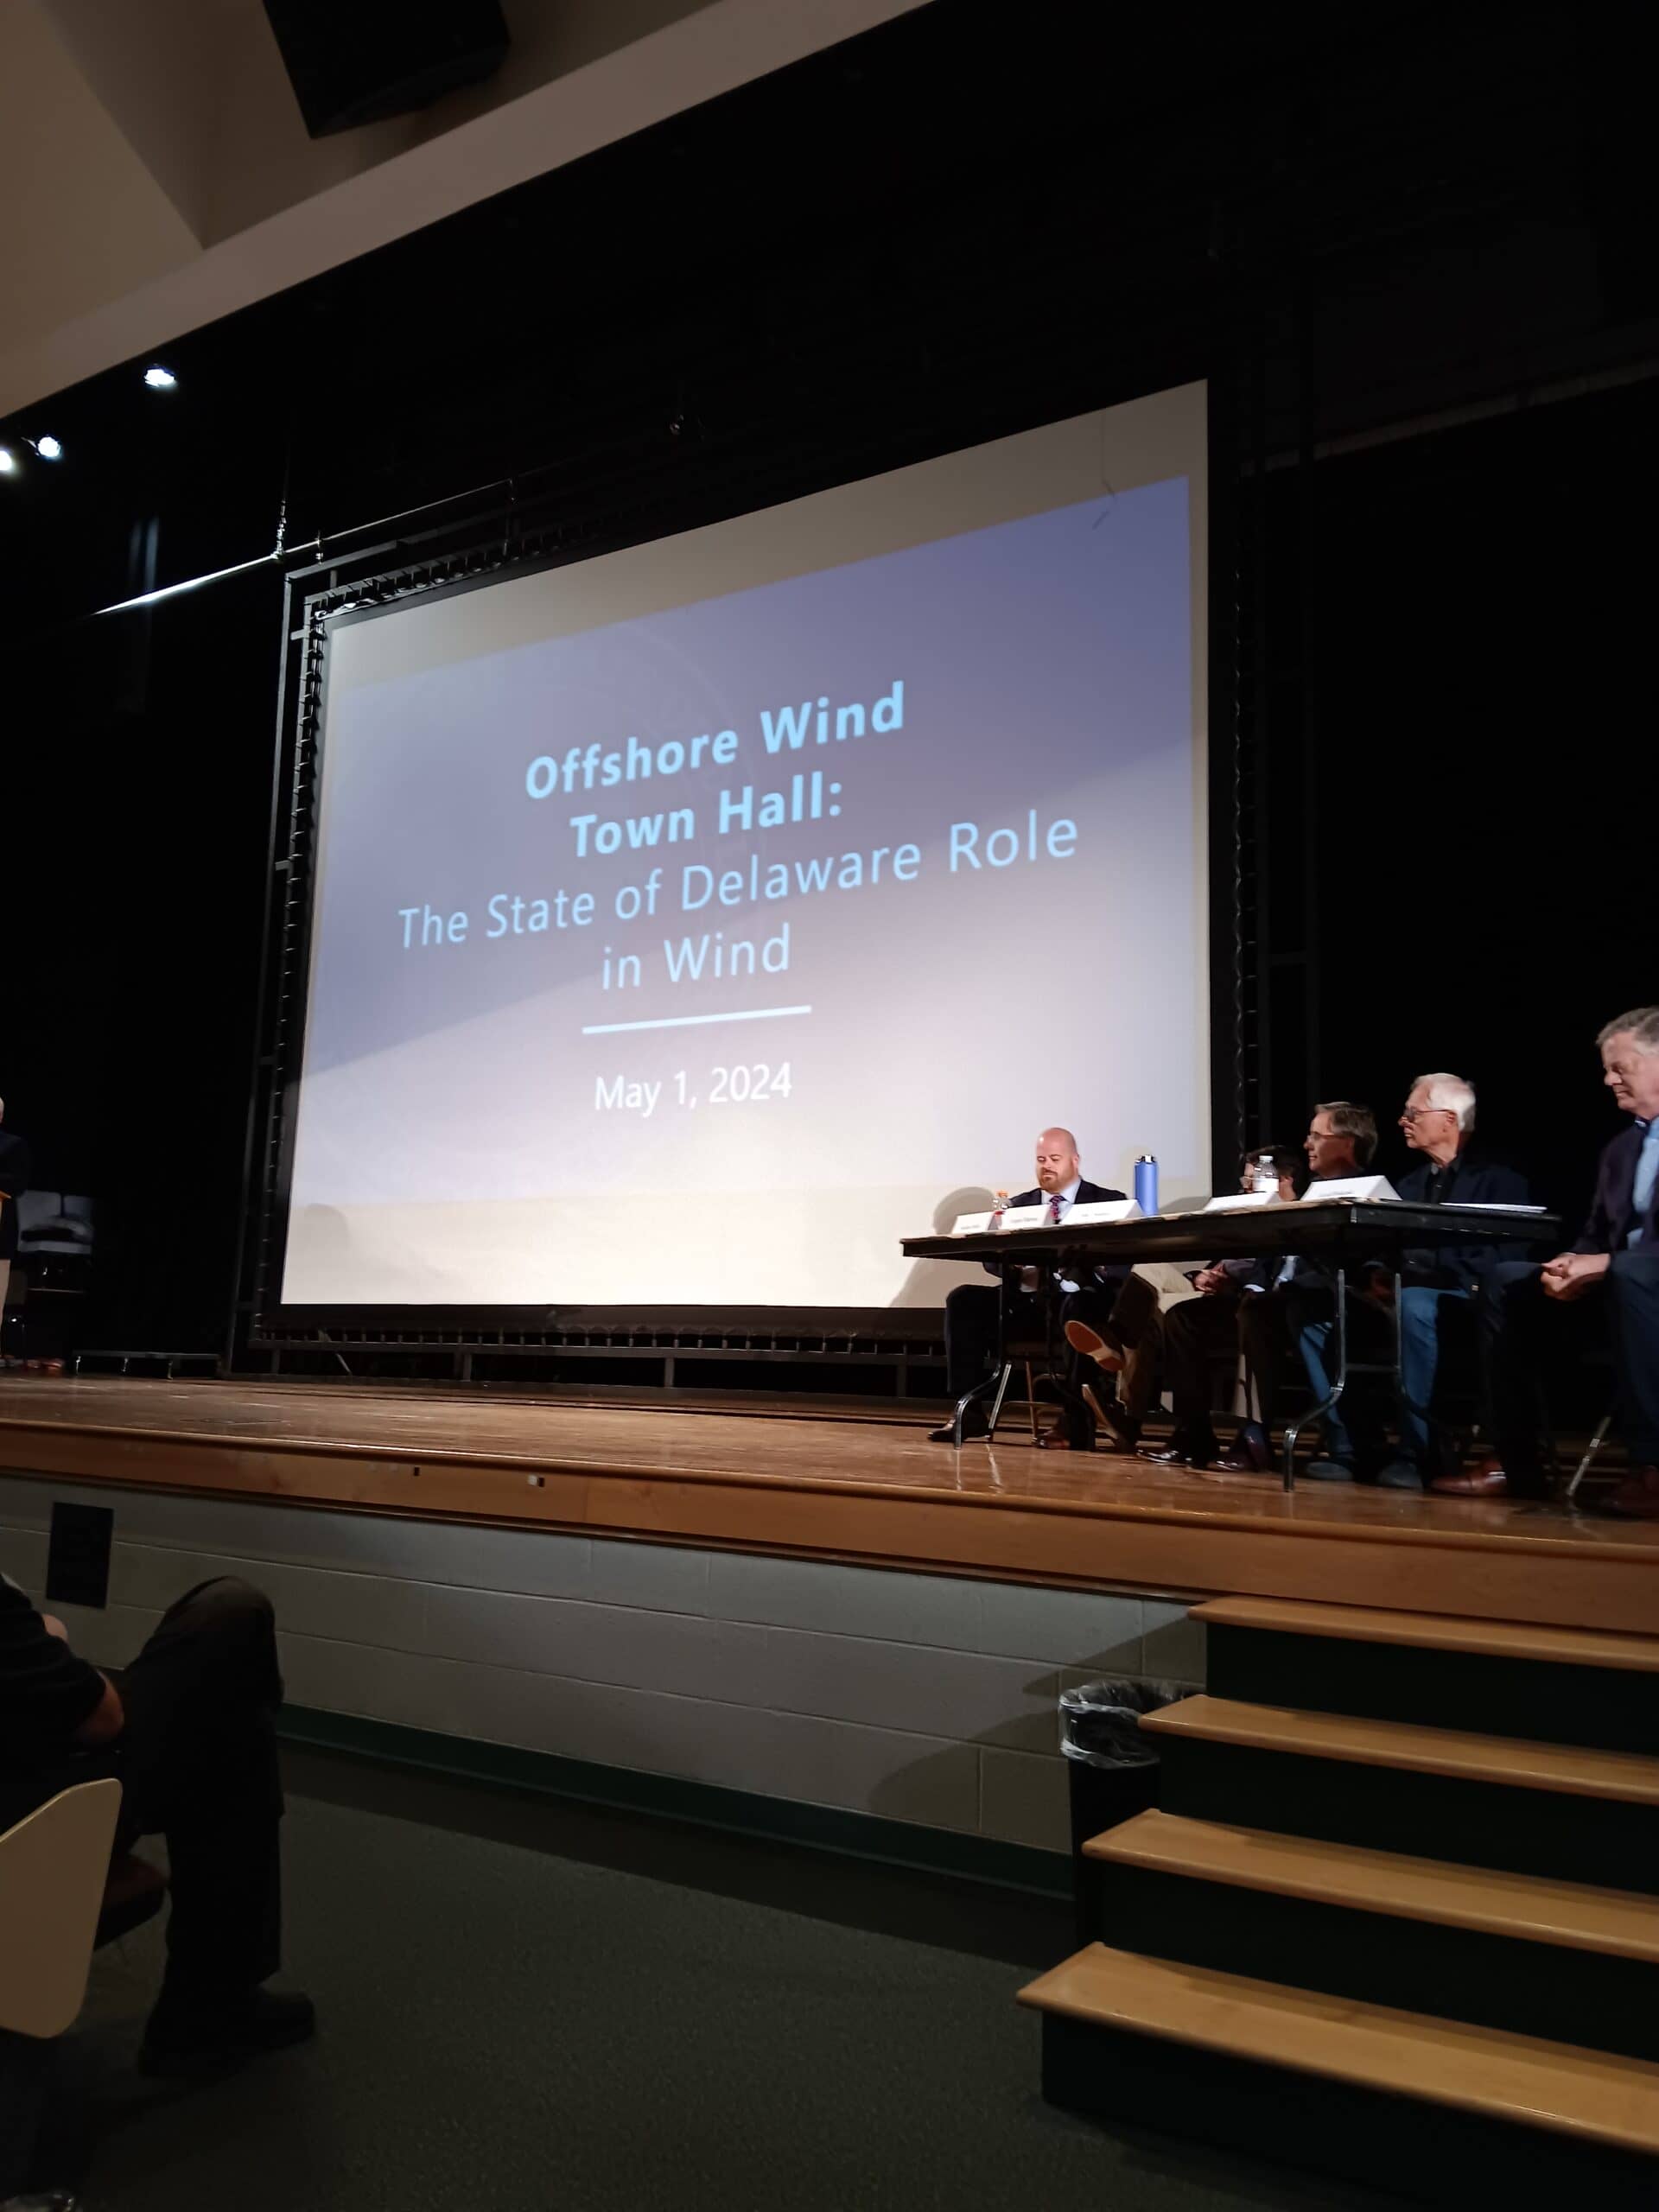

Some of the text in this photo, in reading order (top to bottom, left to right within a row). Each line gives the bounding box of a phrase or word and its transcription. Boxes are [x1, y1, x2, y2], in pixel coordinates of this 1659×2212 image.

[524, 679, 905, 800] Offshore Wind
[569, 770, 842, 859] Town Hall:
[397, 808, 1078, 949] The State of Delaware Role
[602, 921, 791, 990] in Wind
[594, 1061, 792, 1118] May 1, 2024
